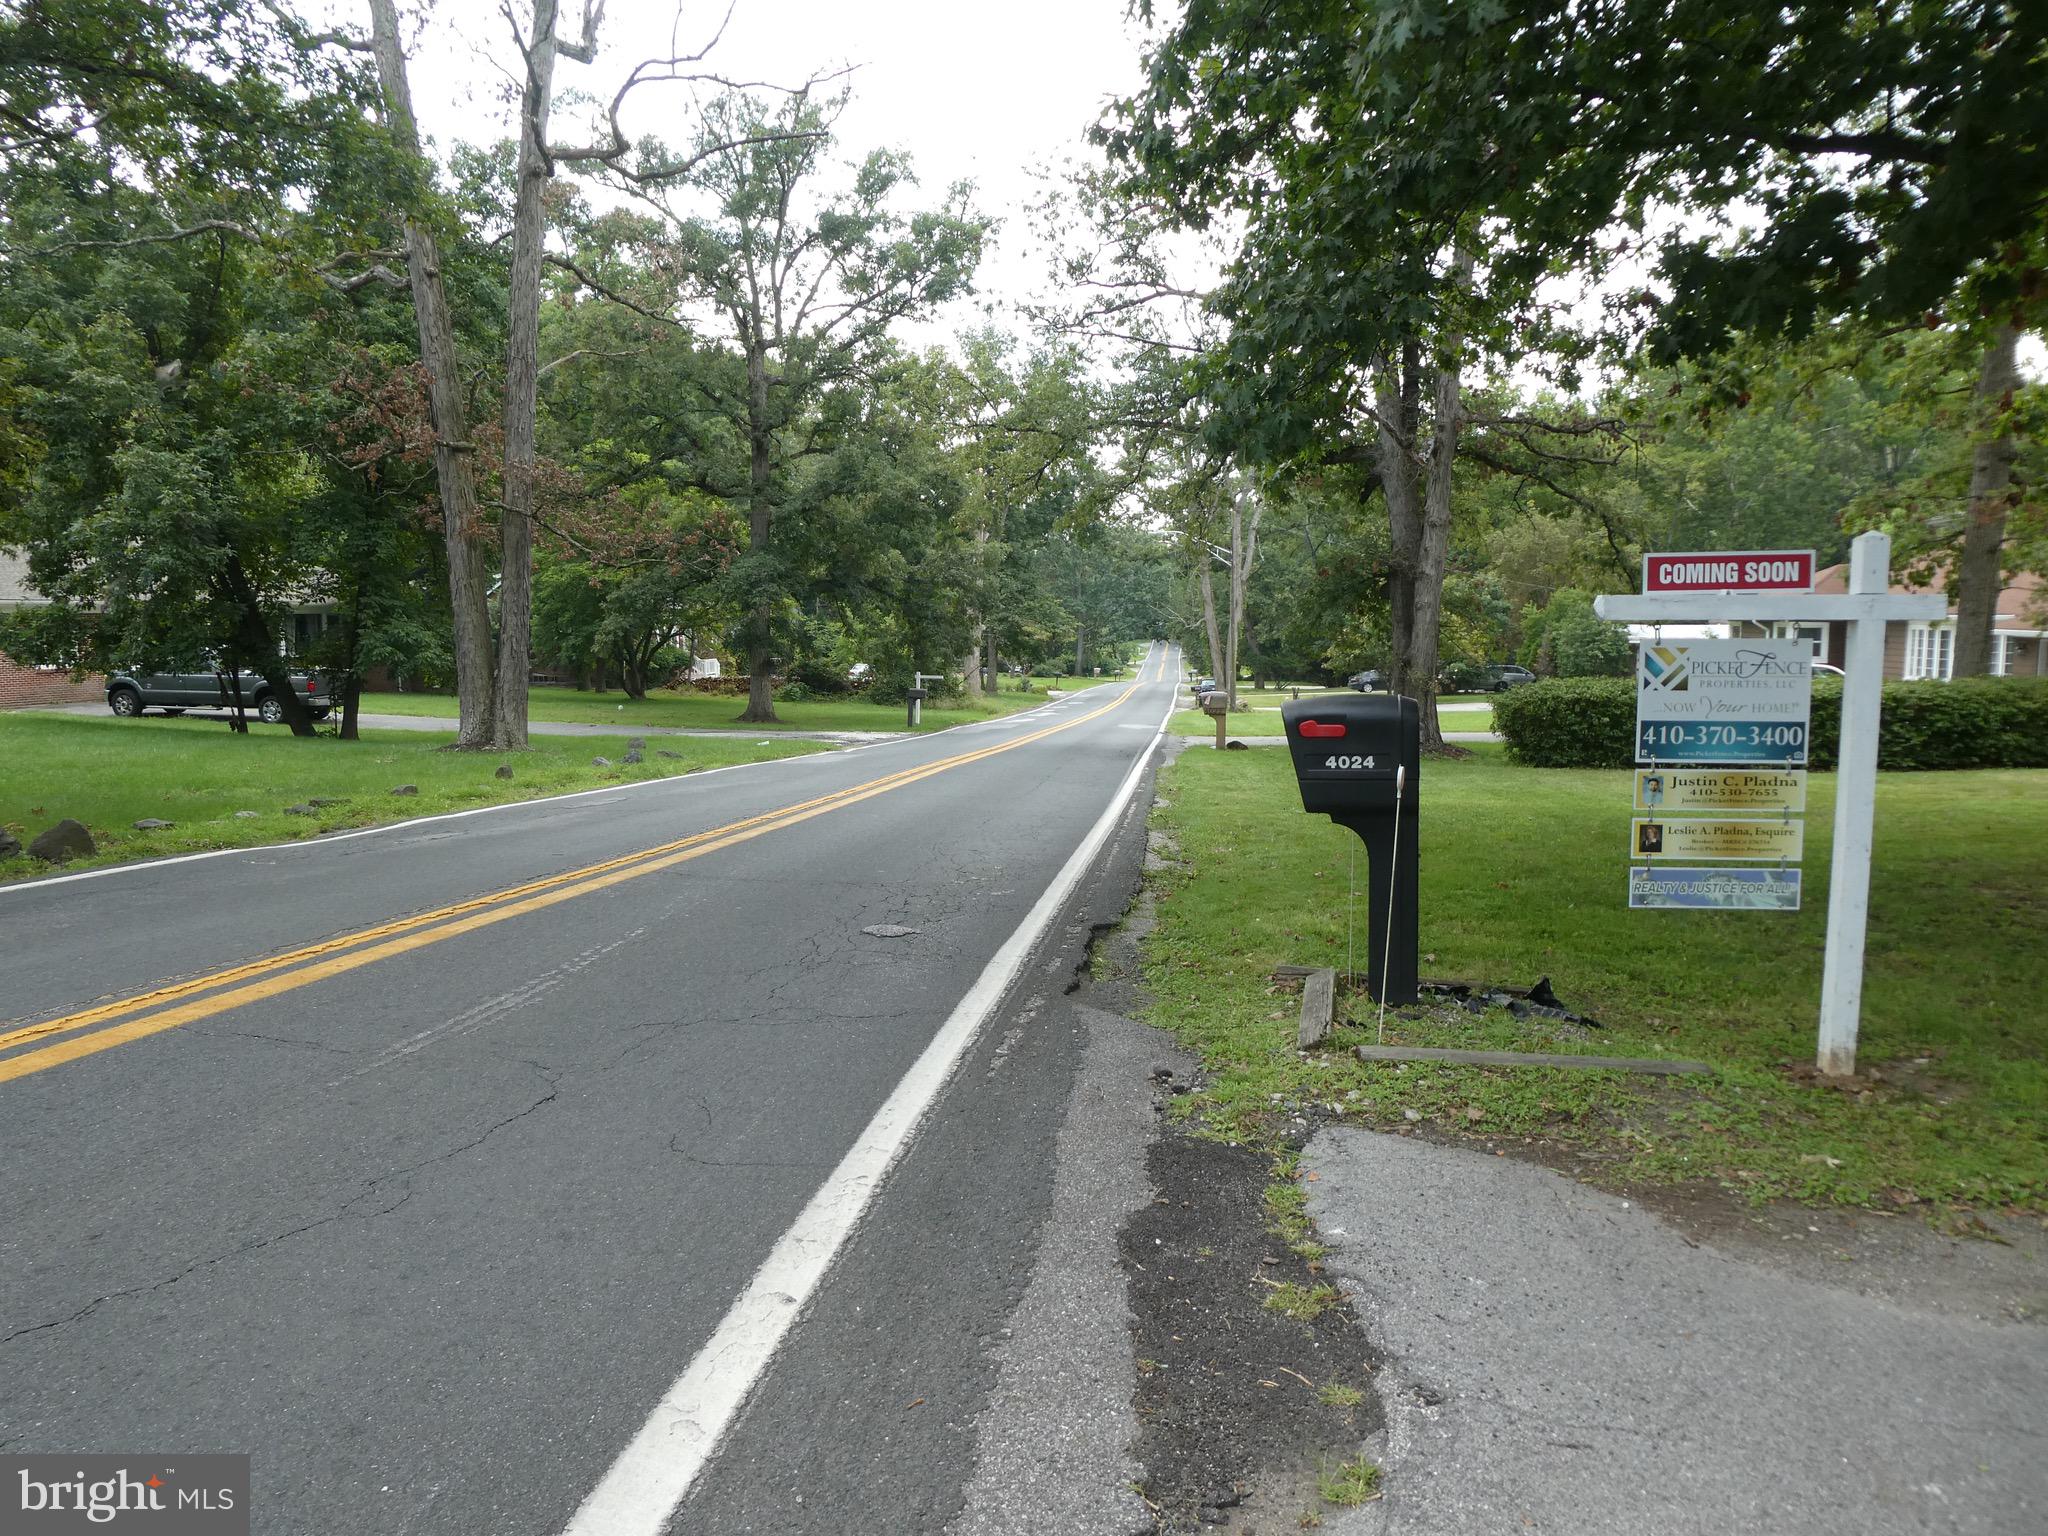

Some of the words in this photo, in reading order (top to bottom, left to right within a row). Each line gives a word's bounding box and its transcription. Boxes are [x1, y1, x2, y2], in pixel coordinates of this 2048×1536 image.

[1659, 563, 1739, 584] COMING
[1744, 561, 1800, 583] SOON
[1775, 679, 1797, 689] LLC
[1700, 695, 1748, 718] Your
[1643, 725, 1803, 746] 410-370-3400
[1325, 755, 1375, 769] 4024
[1671, 776, 1717, 789] Justin
[1723, 776, 1738, 787] C.
[1743, 776, 1798, 787] Pladna
[1689, 789, 1778, 797] 410-530-7655
[1667, 826, 1697, 836] Leslie
[1700, 827, 1711, 836] A.
[1713, 826, 1753, 837] Pladna,
[1755, 828, 1796, 839] Esquire
[1633, 882, 1679, 894] REALTY
[1680, 882, 1688, 894] &
[1690, 883, 1737, 895] JUSTICE
[1739, 883, 1764, 895] FOR
